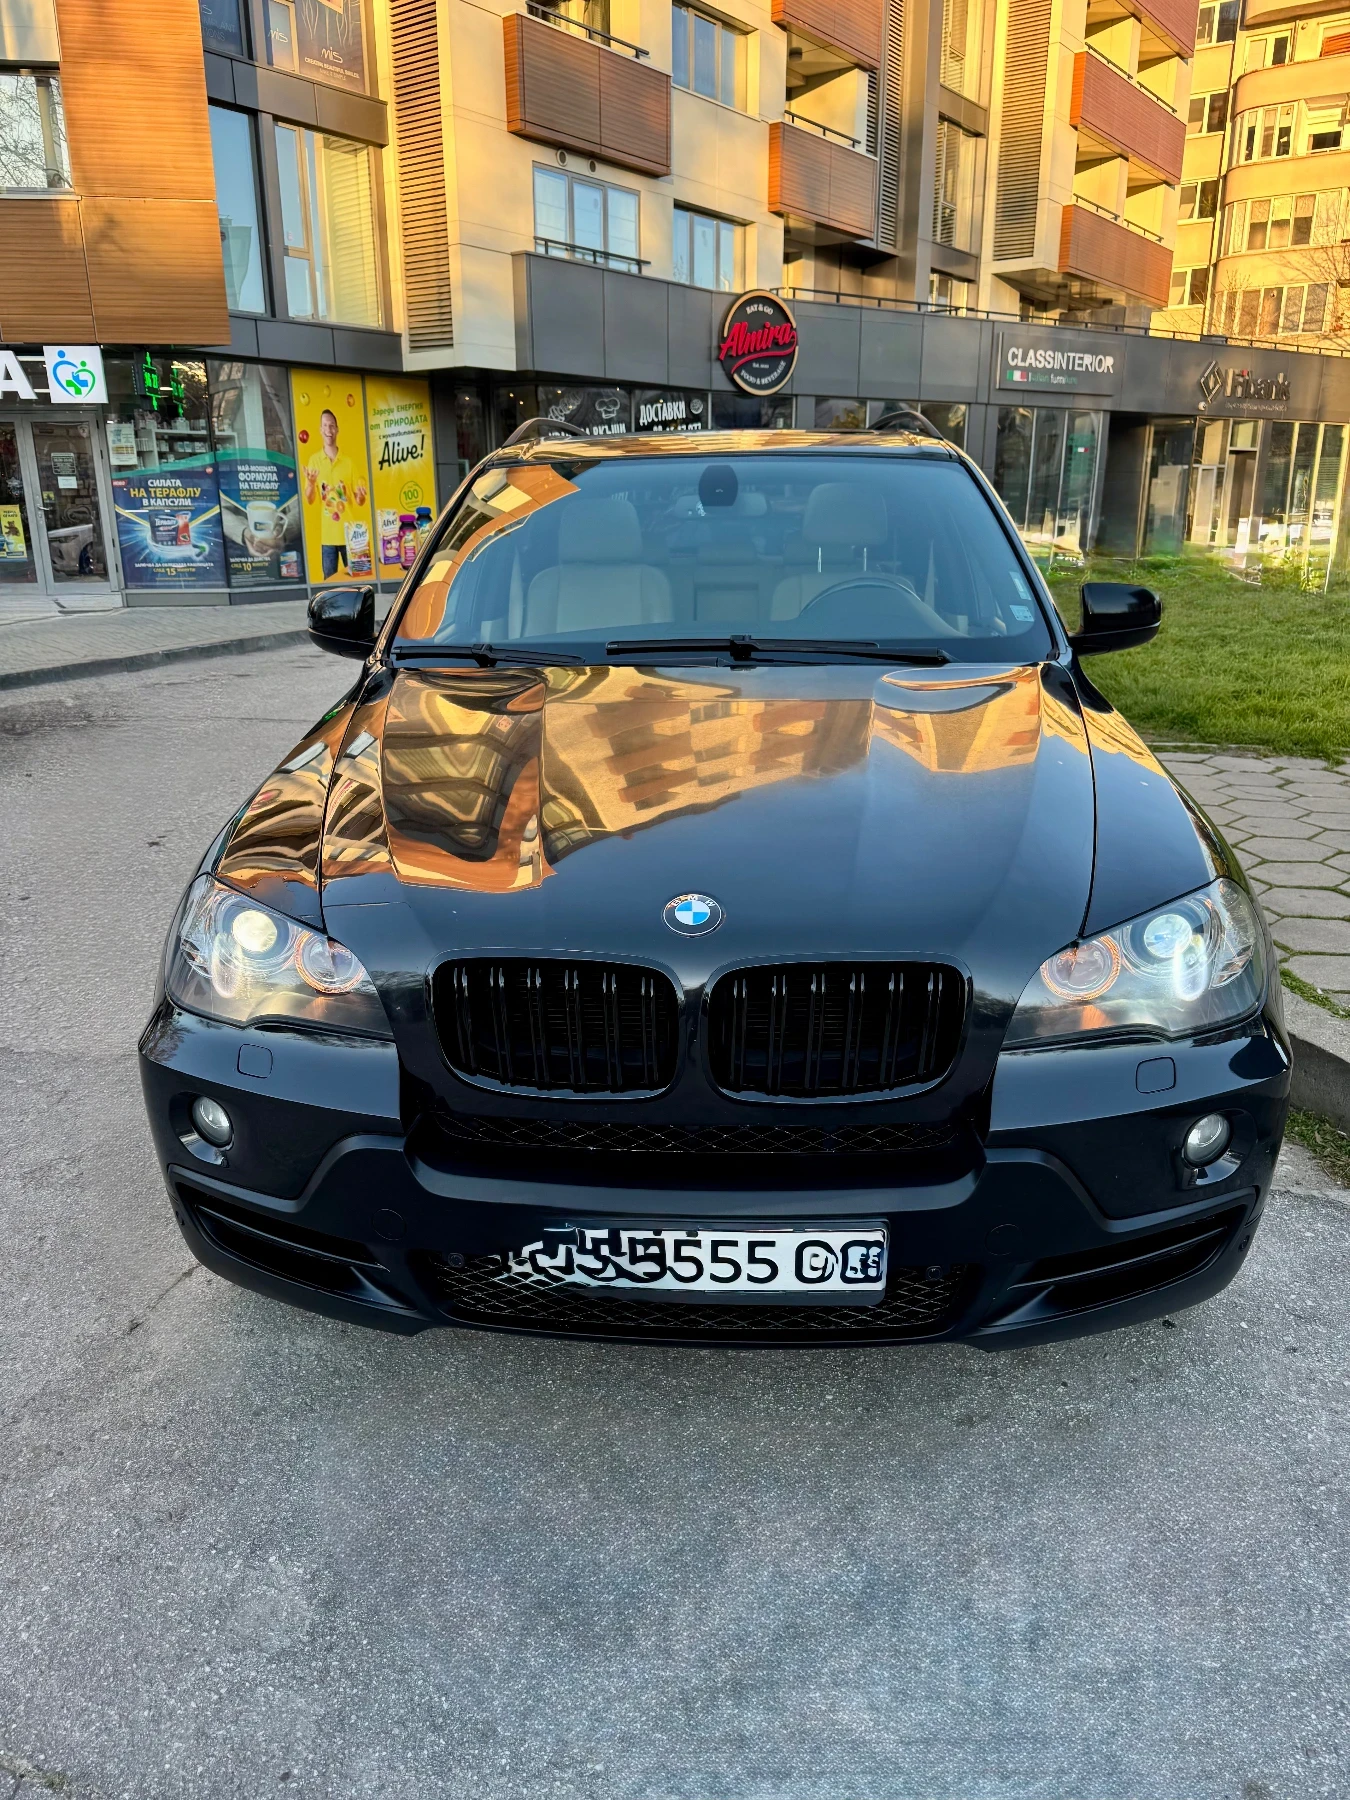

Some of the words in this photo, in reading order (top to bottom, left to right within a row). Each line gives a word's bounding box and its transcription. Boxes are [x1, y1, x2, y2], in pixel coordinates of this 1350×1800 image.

[718, 321, 797, 361] Almira
[1007, 346, 1115, 374] CLASSINTERIOR
[639, 400, 687, 427] ДОСТАВКИ
[384, 414, 428, 429] ПРИРОДАТА
[378, 434, 425, 471] Alive!
[238, 472, 279, 481] ФОРМУЛА
[147, 479, 182, 487] СИЛАТА
[129, 487, 147, 498] НА
[148, 487, 201, 498] ТЕРАФЛУ
[403, 488, 419, 501] 100
[150, 498, 192, 507] КАПСУЛИ
[166, 568, 177, 576] 15
[242, 562, 252, 571] 10
